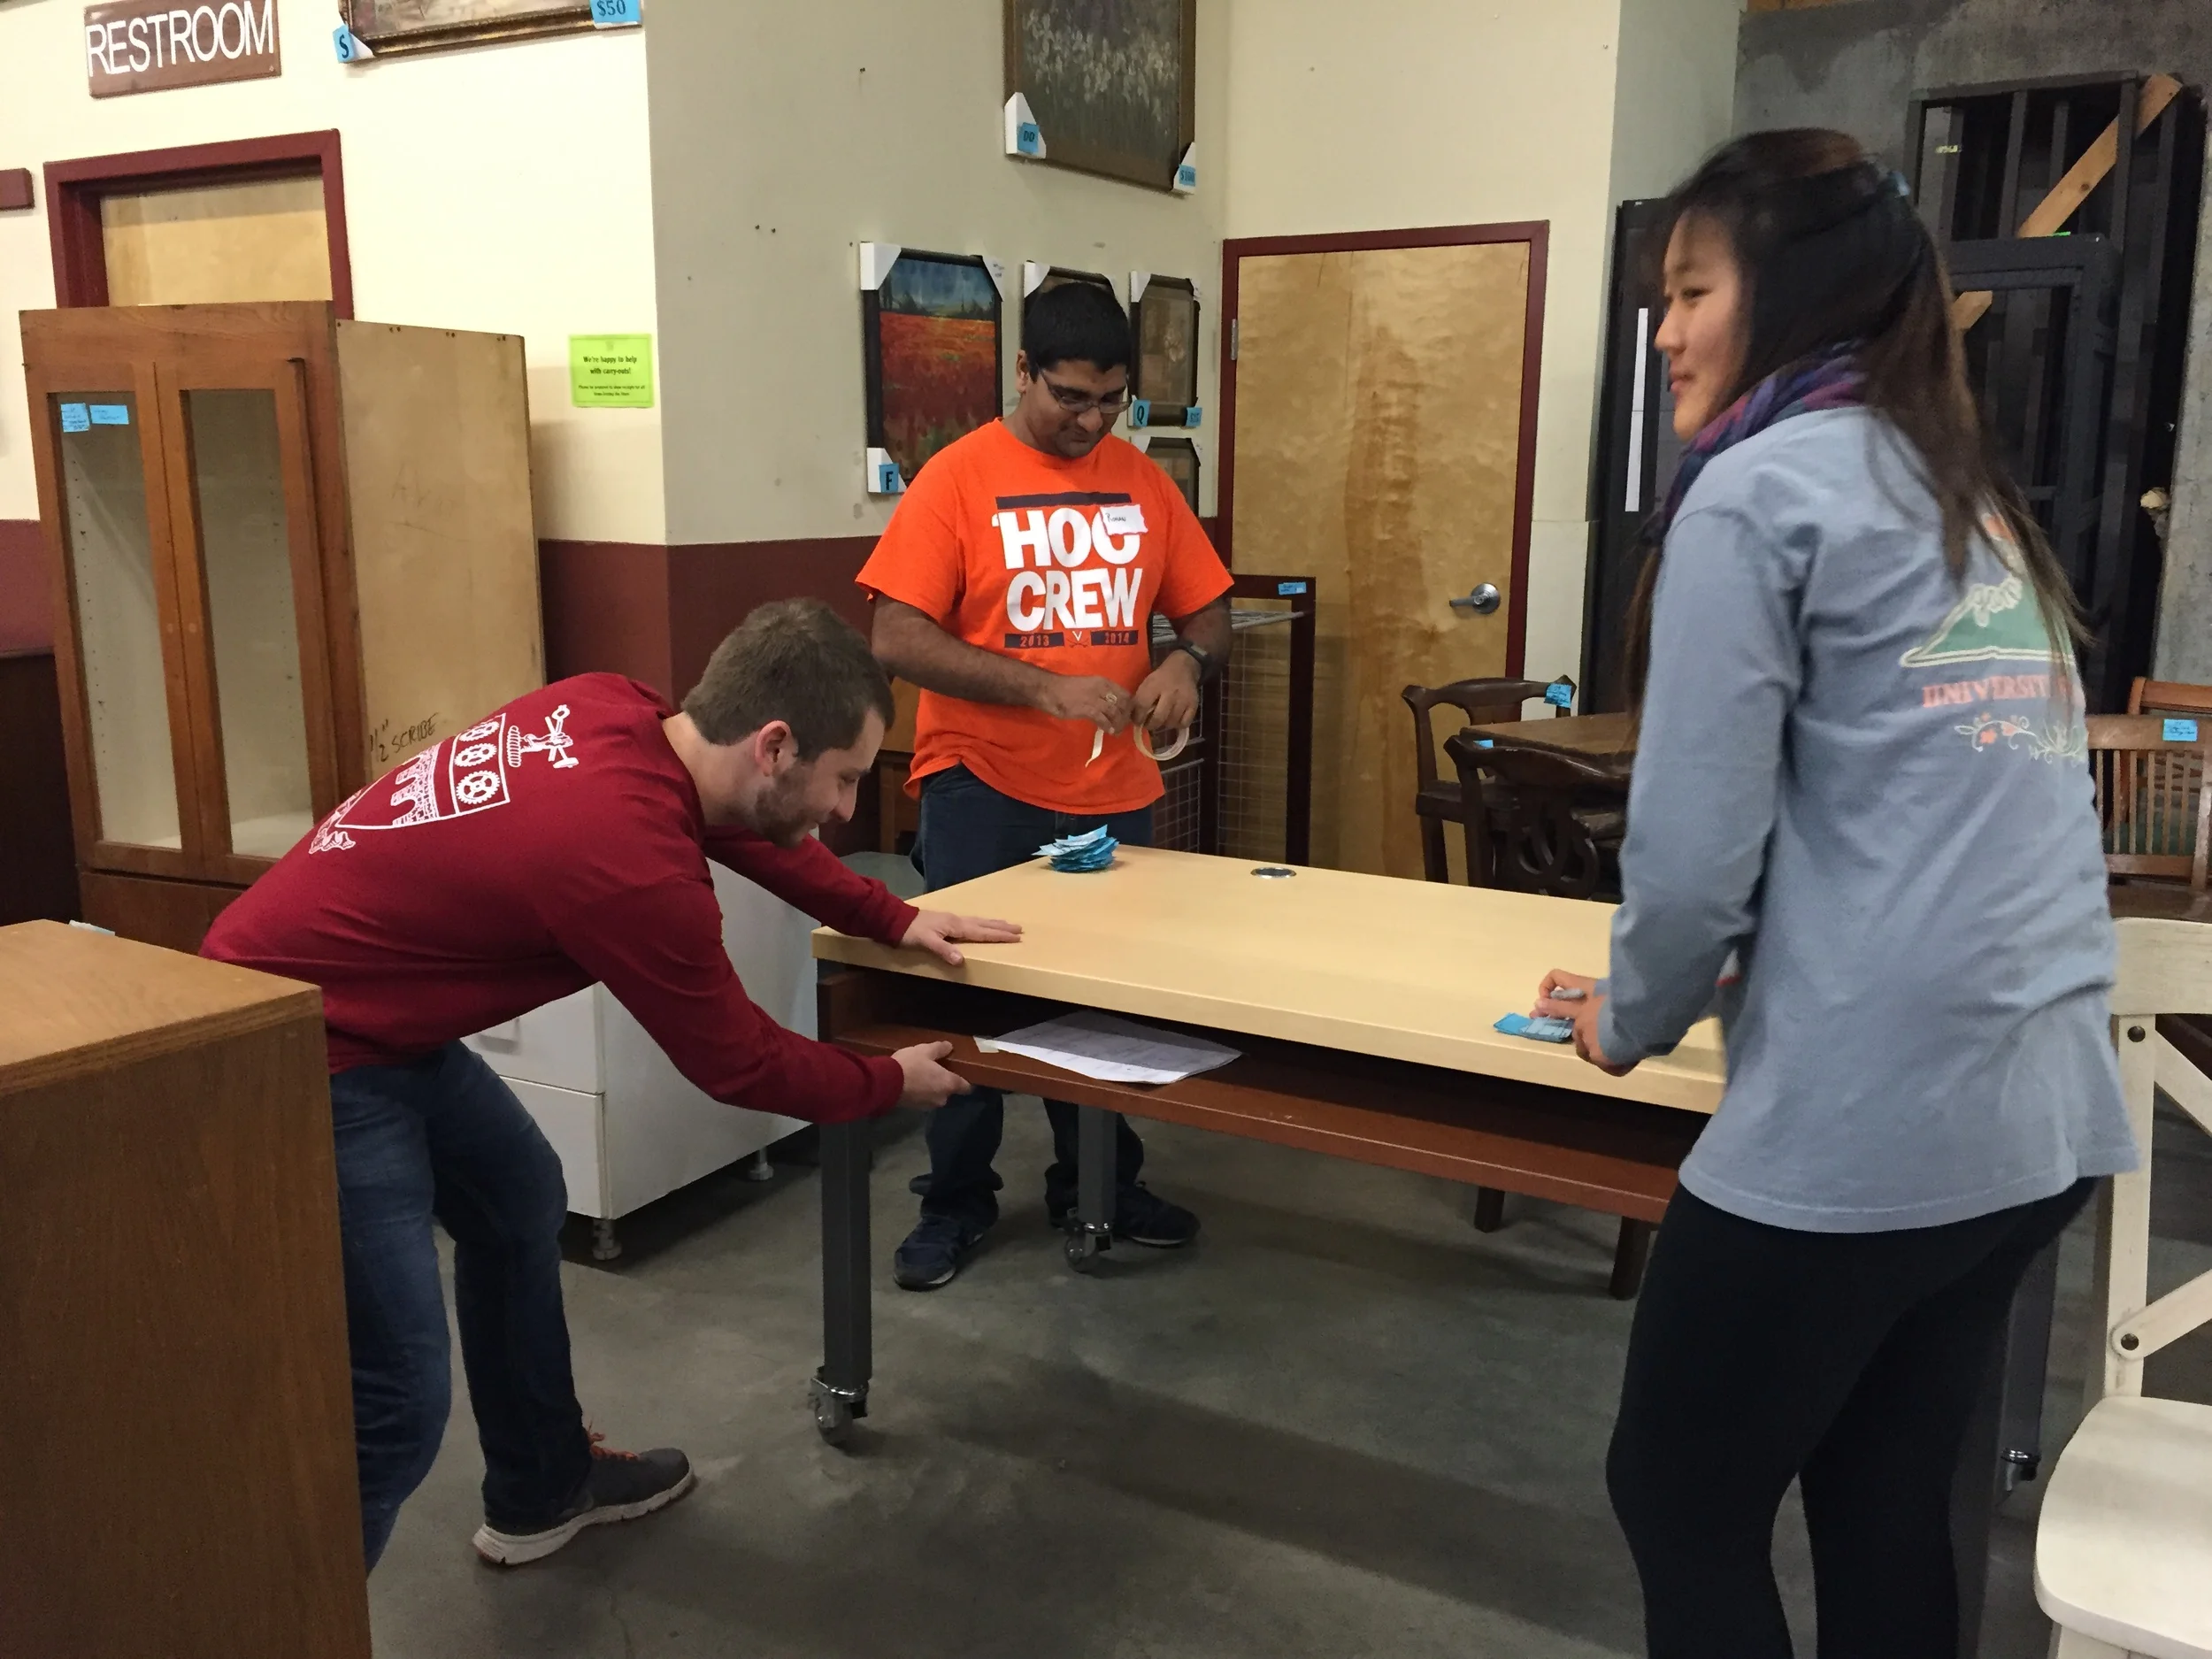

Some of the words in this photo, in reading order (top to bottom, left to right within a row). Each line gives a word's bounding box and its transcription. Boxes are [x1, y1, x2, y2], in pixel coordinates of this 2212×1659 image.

[597, 0, 626, 17] $50
[85, 0, 273, 77] RESTROOM
[625, 355, 637, 364] help
[1137, 405, 1145, 425] Q
[886, 471, 894, 491] F
[1007, 567, 1143, 632] CREW
[1020, 634, 1049, 647] 2013
[1105, 633, 1130, 644] 2014
[391, 712, 439, 754] SCRIBE
